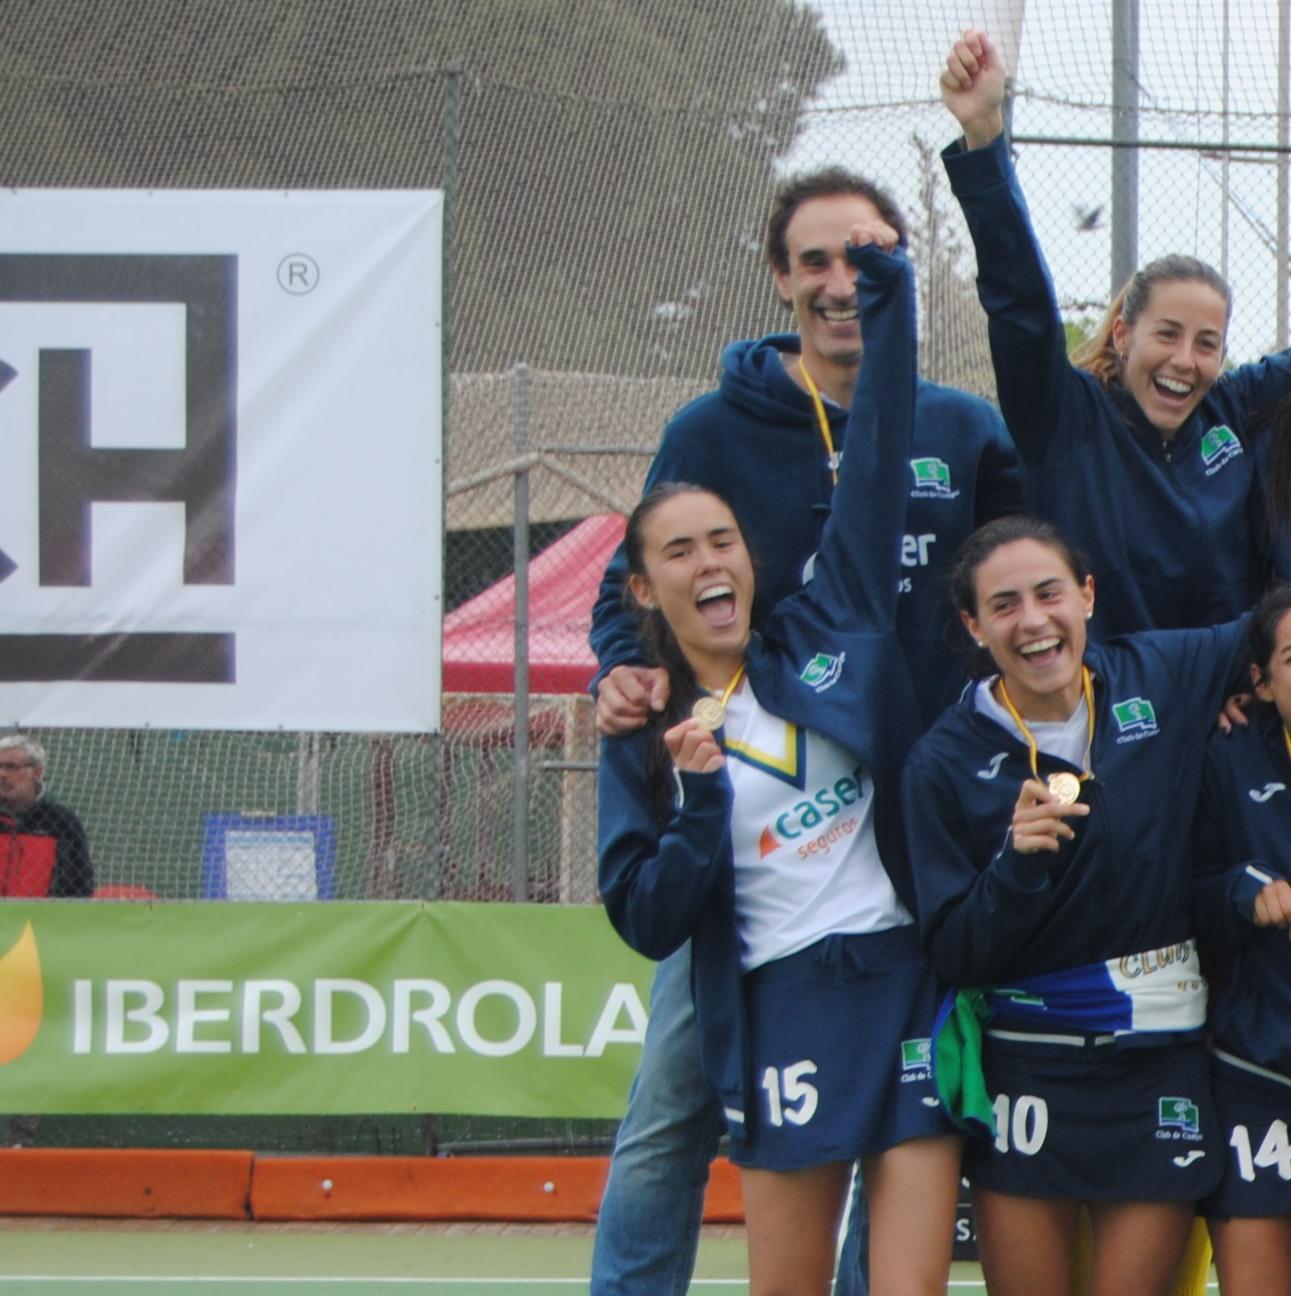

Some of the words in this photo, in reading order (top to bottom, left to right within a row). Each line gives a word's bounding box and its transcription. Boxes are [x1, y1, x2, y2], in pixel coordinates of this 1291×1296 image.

[776, 766, 864, 839] caser
[73, 979, 650, 1057] IBERDROLA
[762, 1060, 818, 1128] 15
[991, 1094, 1048, 1155] 10
